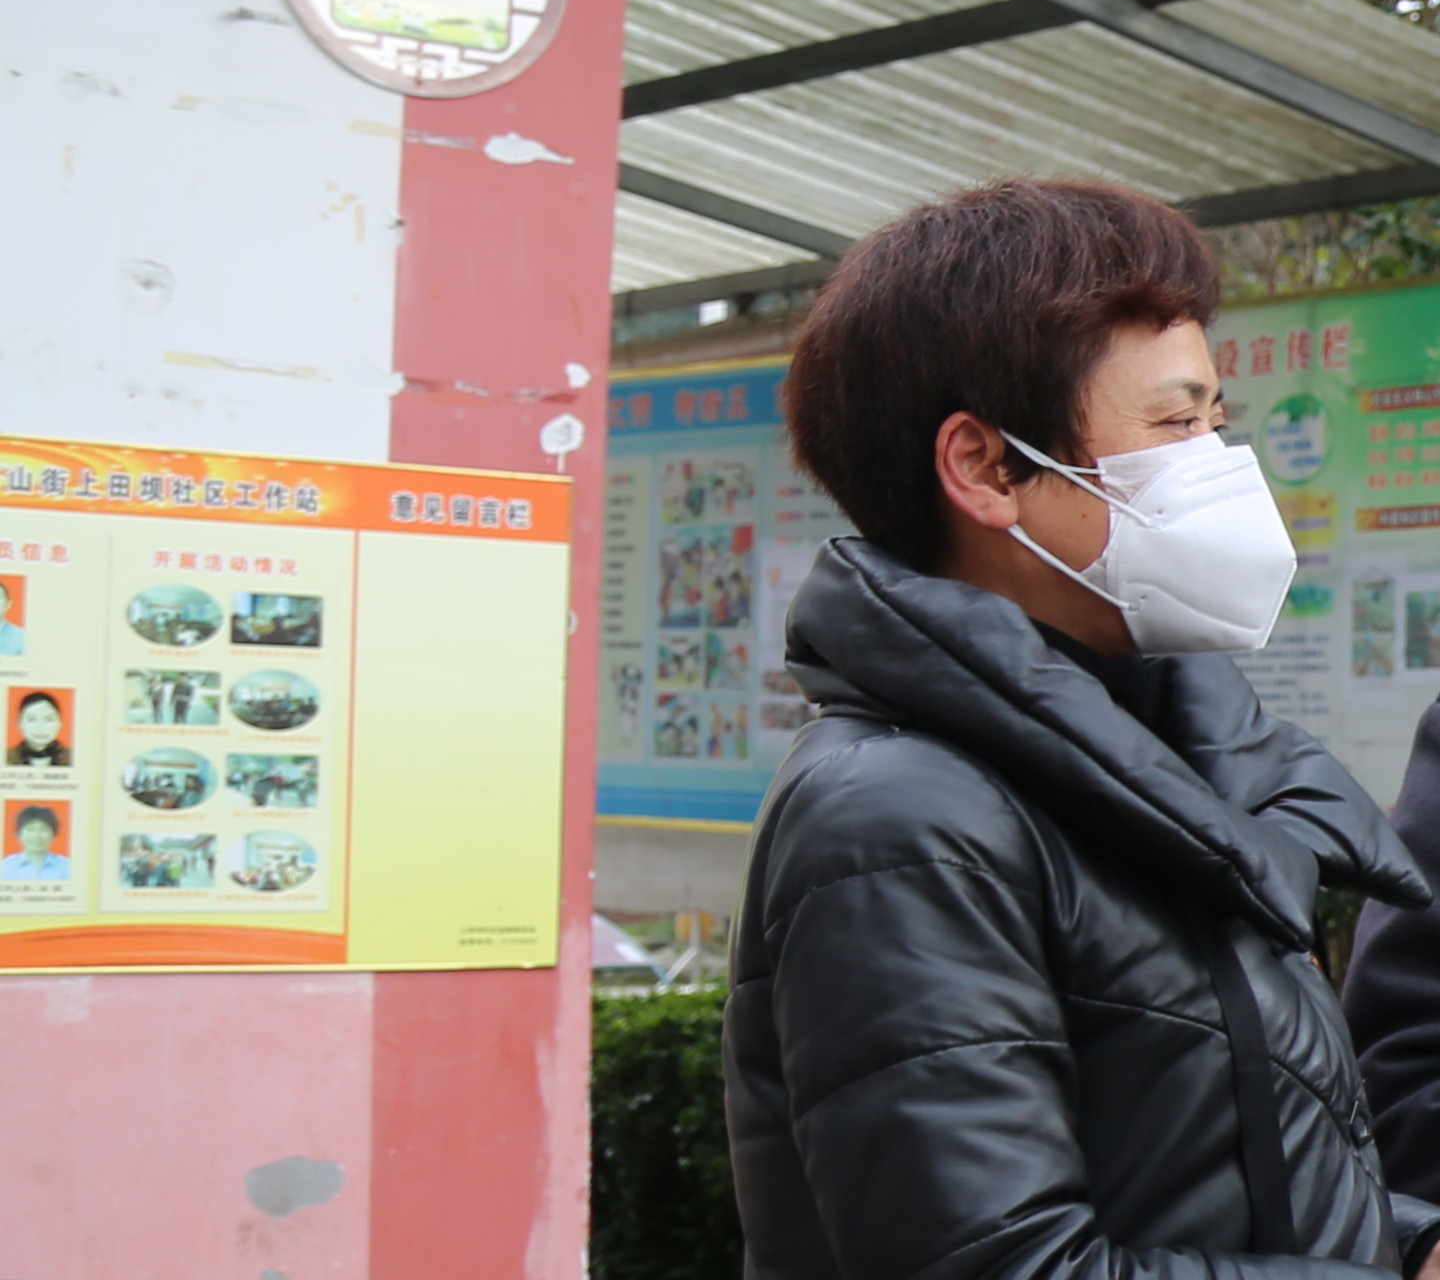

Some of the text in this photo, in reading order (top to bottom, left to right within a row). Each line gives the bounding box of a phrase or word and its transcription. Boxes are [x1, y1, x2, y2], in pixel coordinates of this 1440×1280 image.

[0, 464, 320, 513] 山街上田坝社区工作站
[391, 491, 532, 529] 意见留言栏
[153, 550, 299, 576] 开展活动情况
